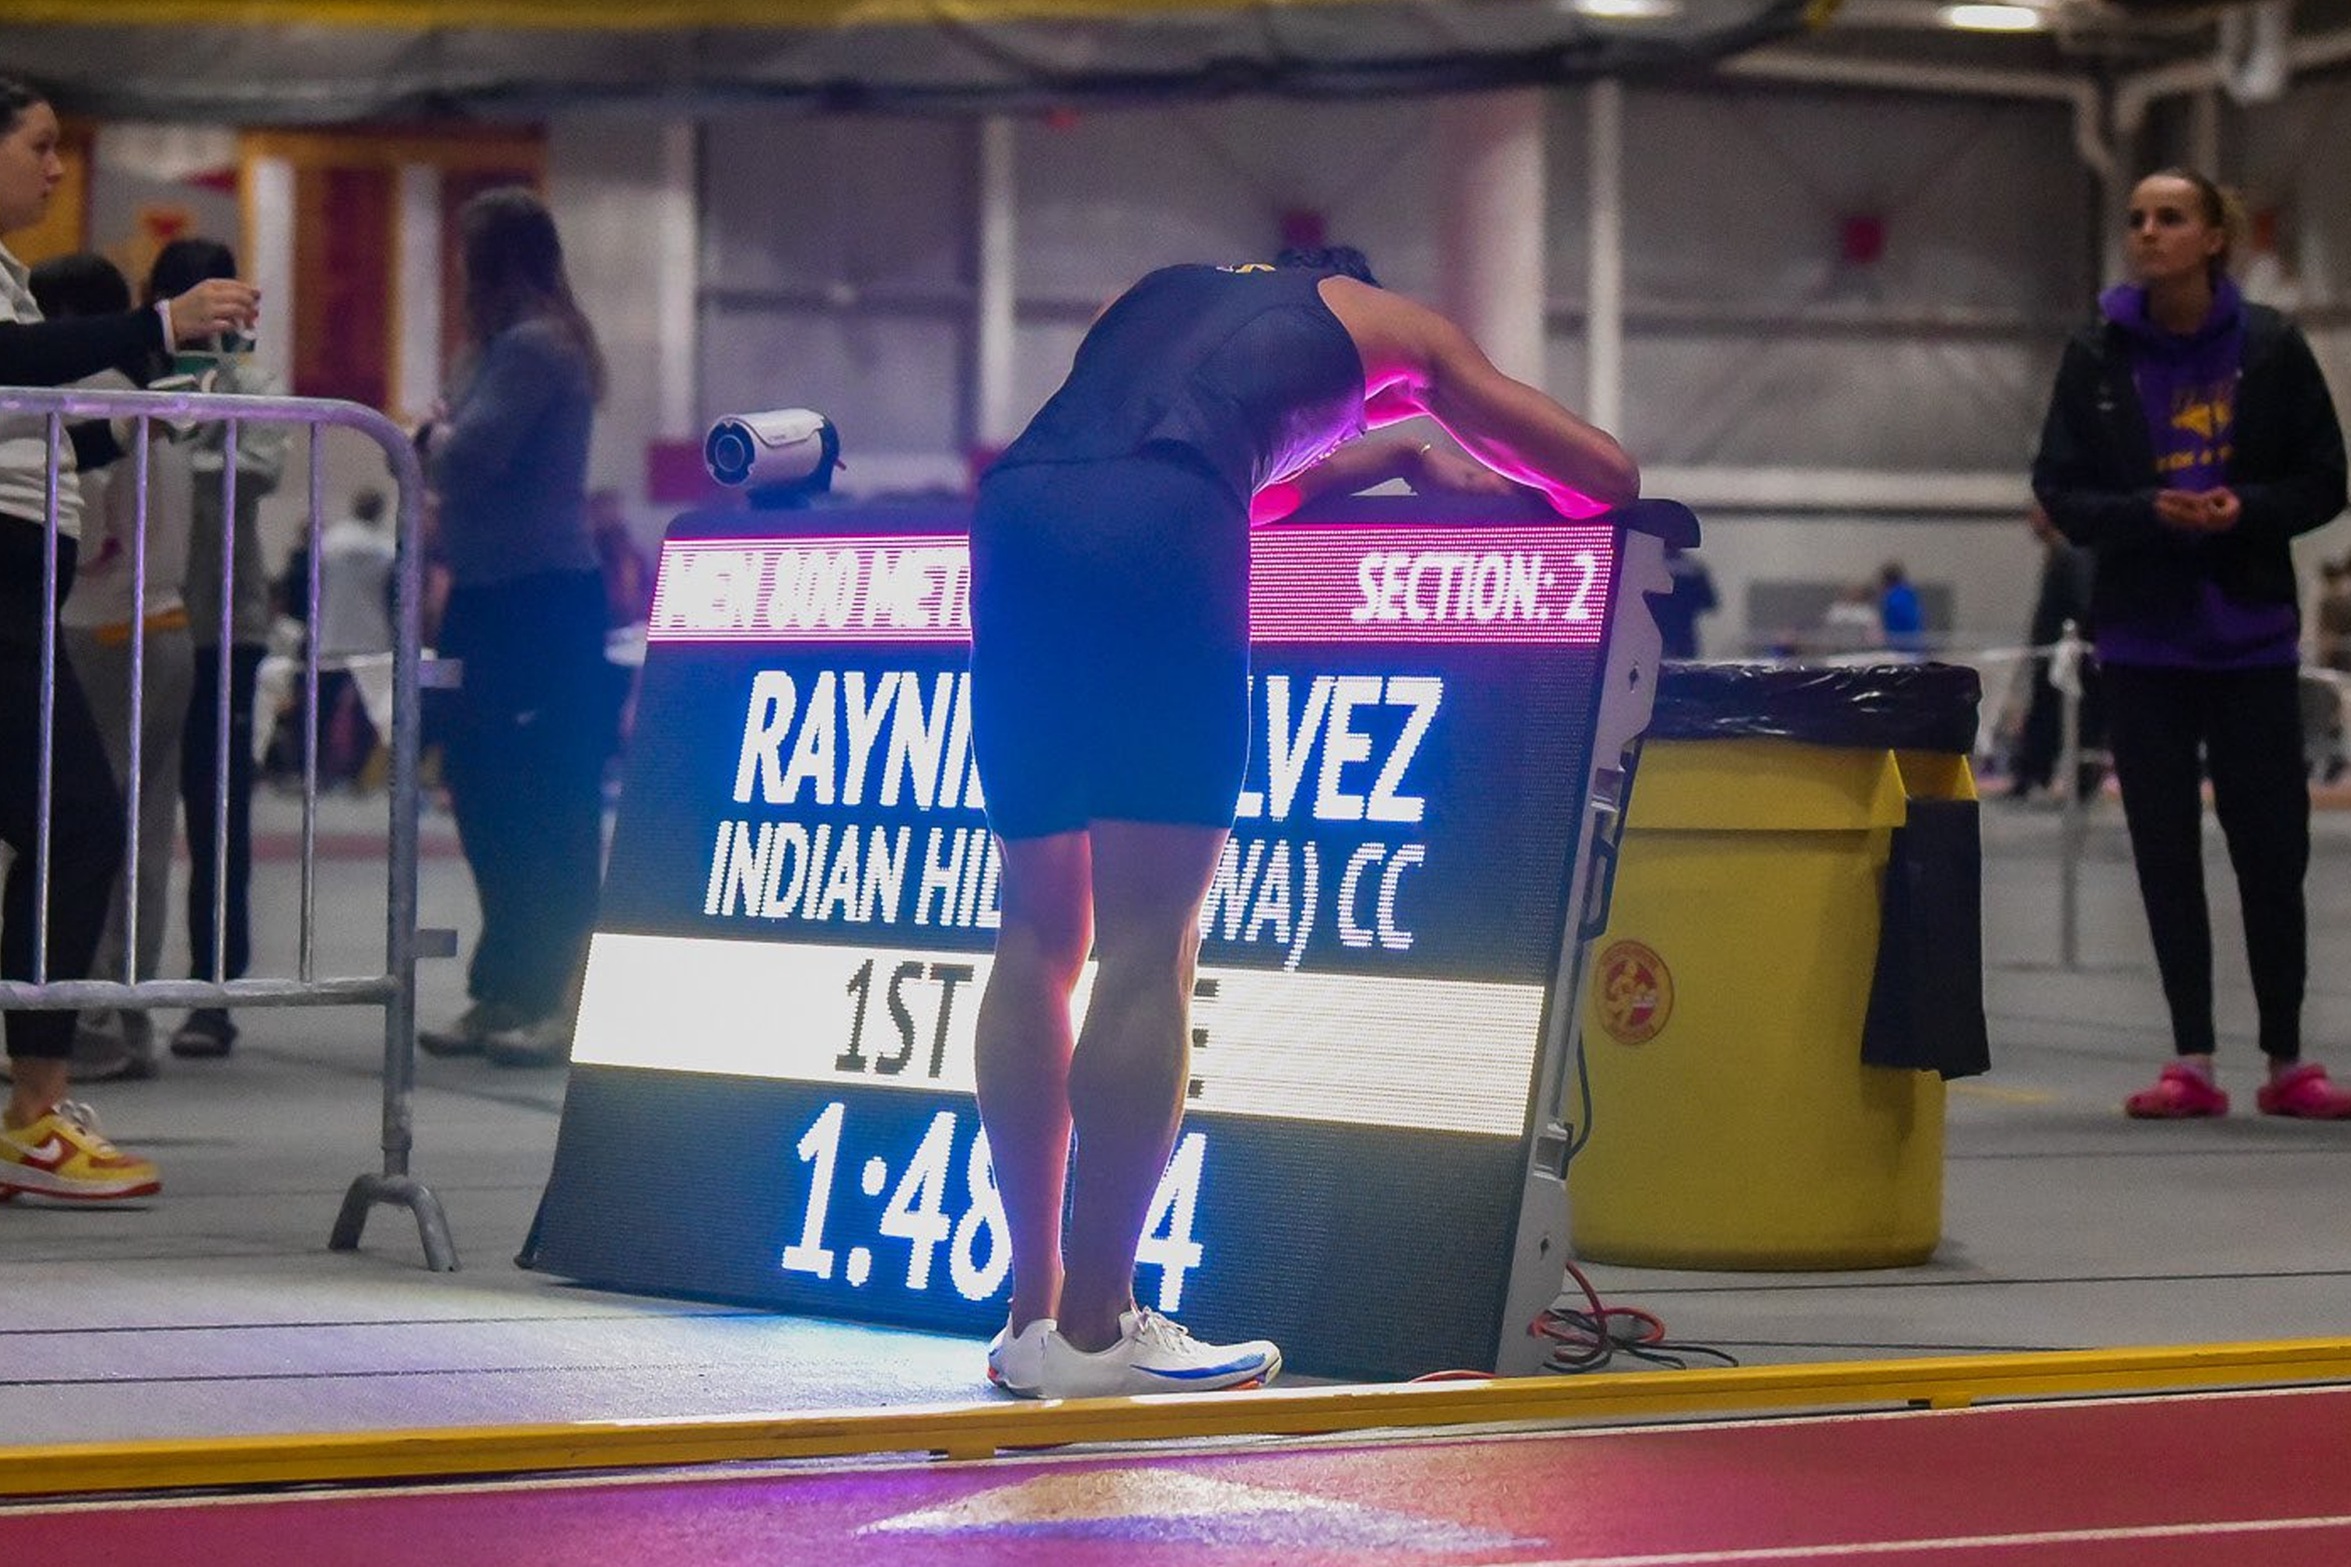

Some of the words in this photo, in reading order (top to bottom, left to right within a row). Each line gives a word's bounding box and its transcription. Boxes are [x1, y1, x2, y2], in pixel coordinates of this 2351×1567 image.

[660, 550, 765, 628] MEN
[769, 549, 856, 628] 800
[1350, 551, 1555, 620] SECTION:
[1561, 551, 1596, 620] 2
[733, 670, 986, 811] RAYNI
[704, 821, 910, 923] INDIAN
[1337, 842, 1425, 949] CC
[835, 959, 974, 1078] 1ST
